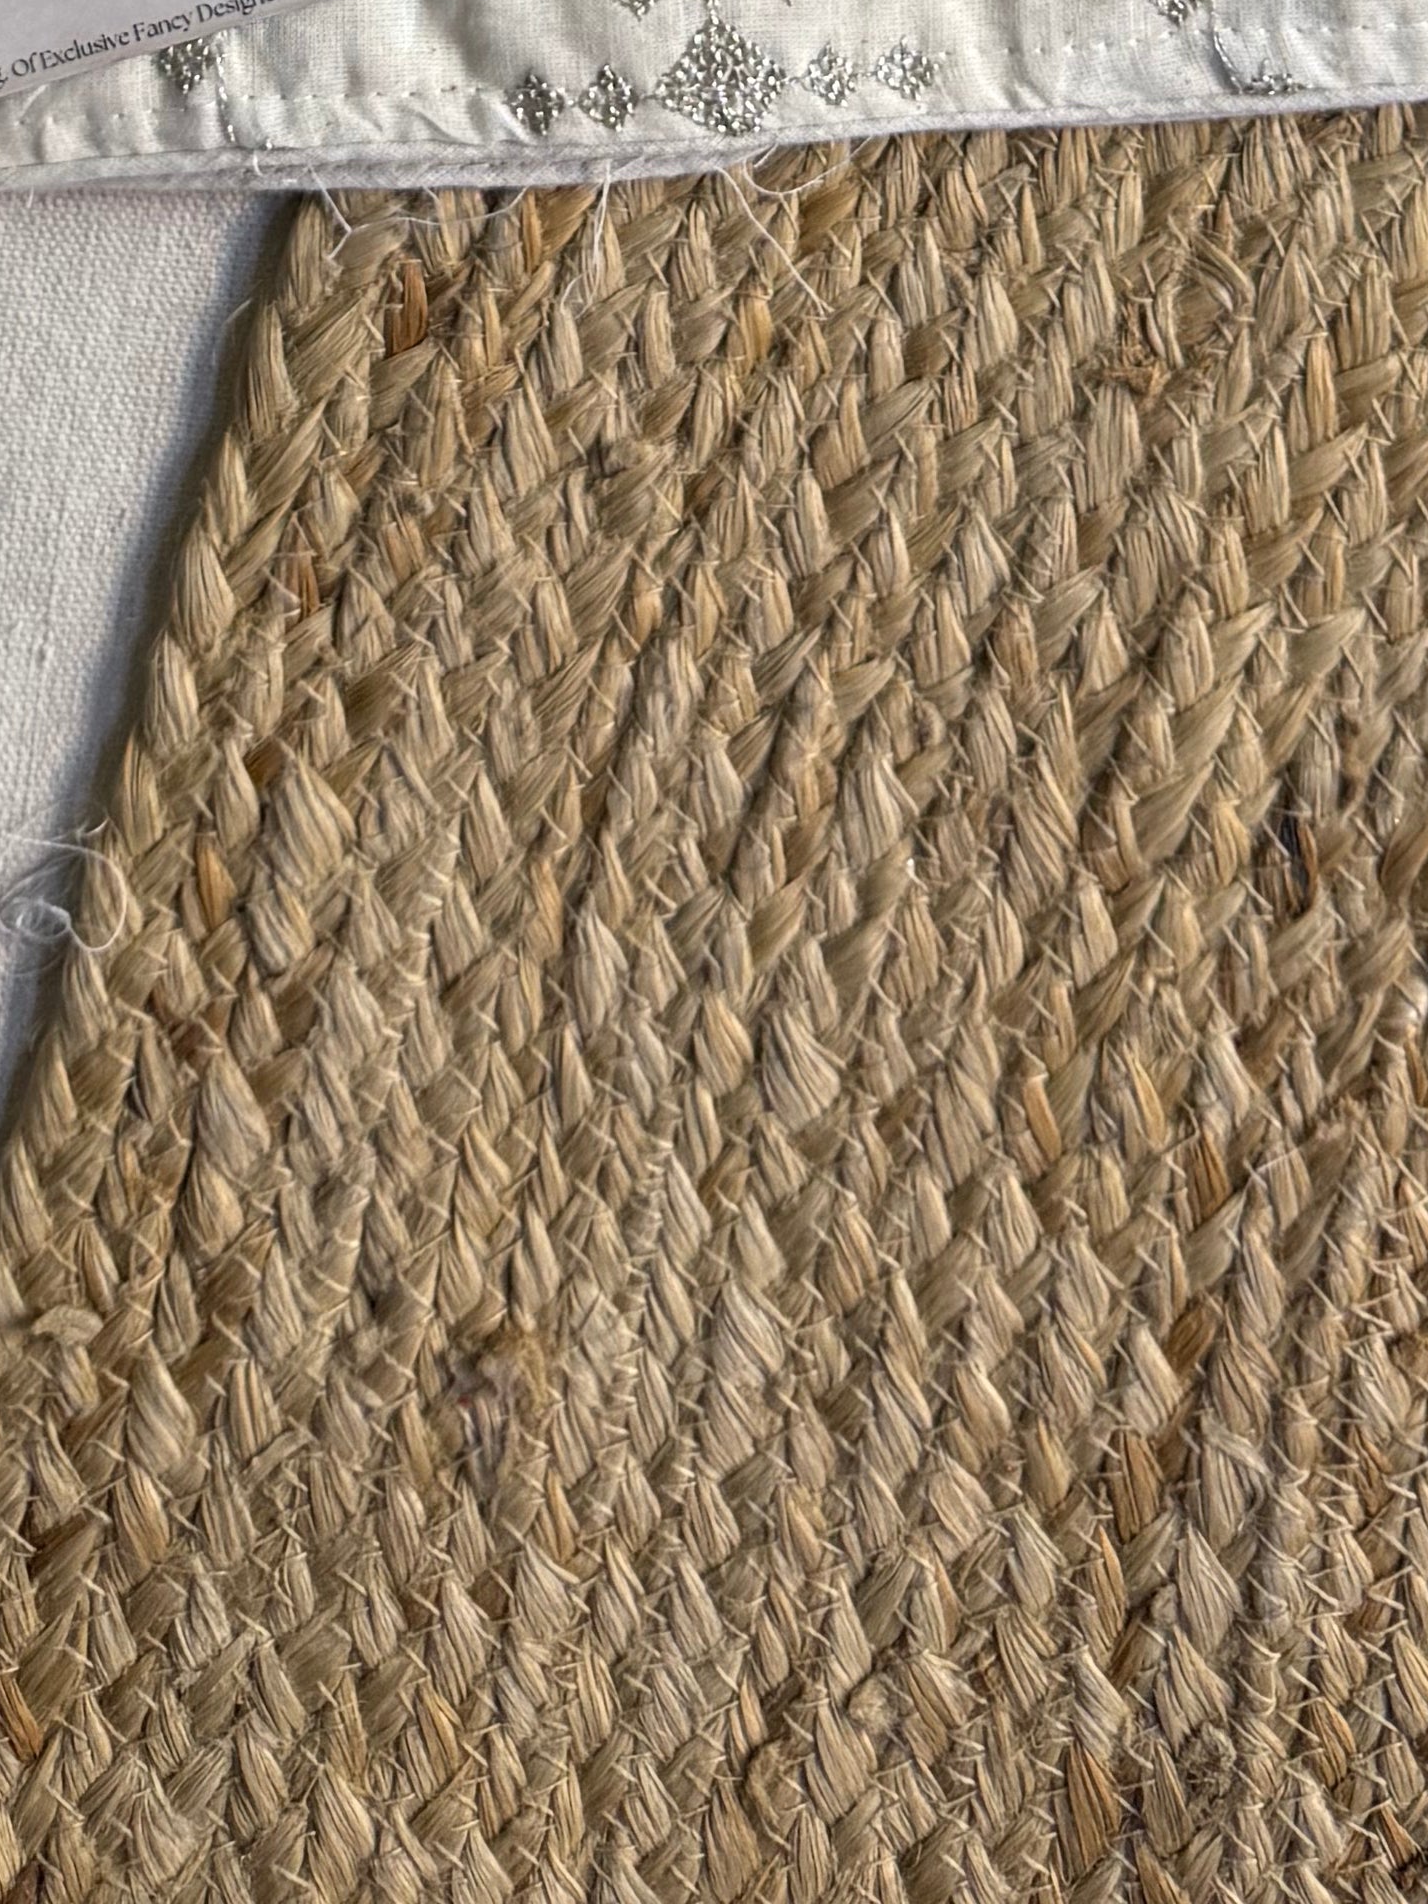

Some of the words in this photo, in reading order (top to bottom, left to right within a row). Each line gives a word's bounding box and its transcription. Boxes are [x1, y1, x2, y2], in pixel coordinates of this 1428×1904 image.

[10, 51, 37, 78] Of
[38, 29, 130, 71] Exclusive
[132, 10, 194, 42] Fancy
